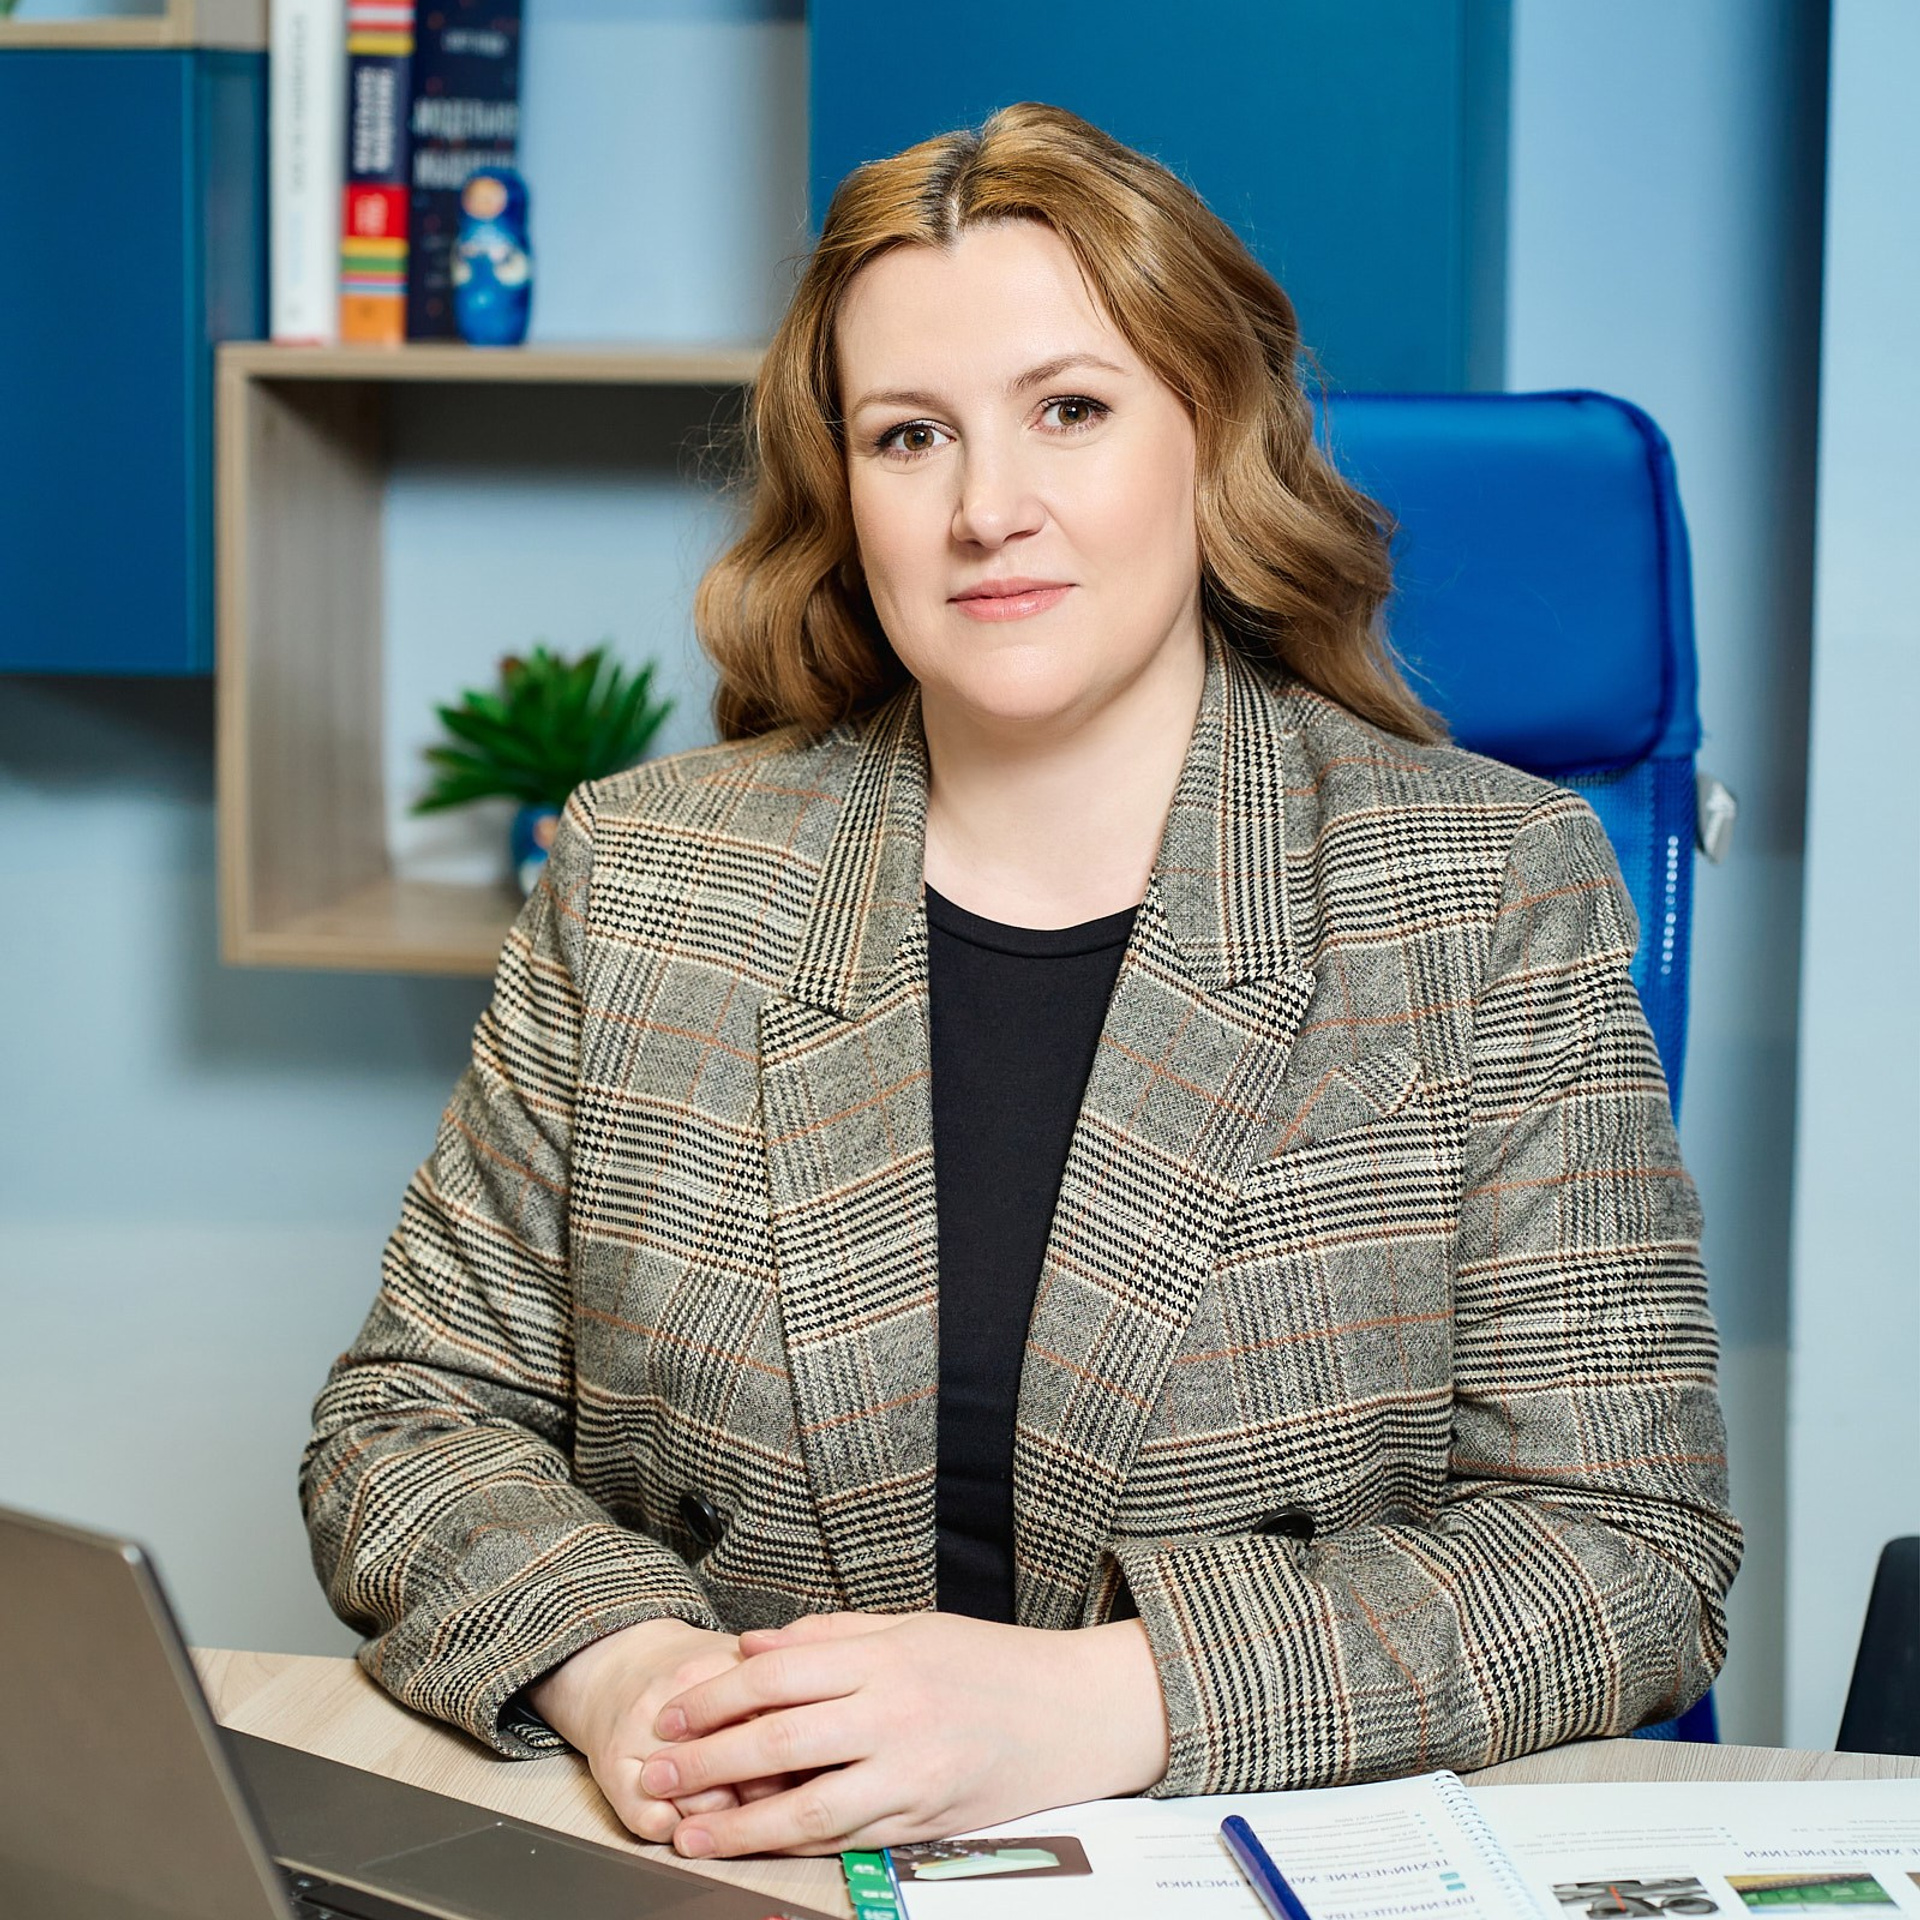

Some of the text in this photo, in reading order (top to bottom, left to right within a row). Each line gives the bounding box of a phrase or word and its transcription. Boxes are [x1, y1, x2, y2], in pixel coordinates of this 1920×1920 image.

[1744, 1849, 1902, 1859] ХАРАКТЕРИСТИКИ
[1324, 1859, 1450, 1882] ТЕХНИЧЕСКИЕ
[1323, 1895, 1475, 1920] ПРЕИМУЩЕСТВА
